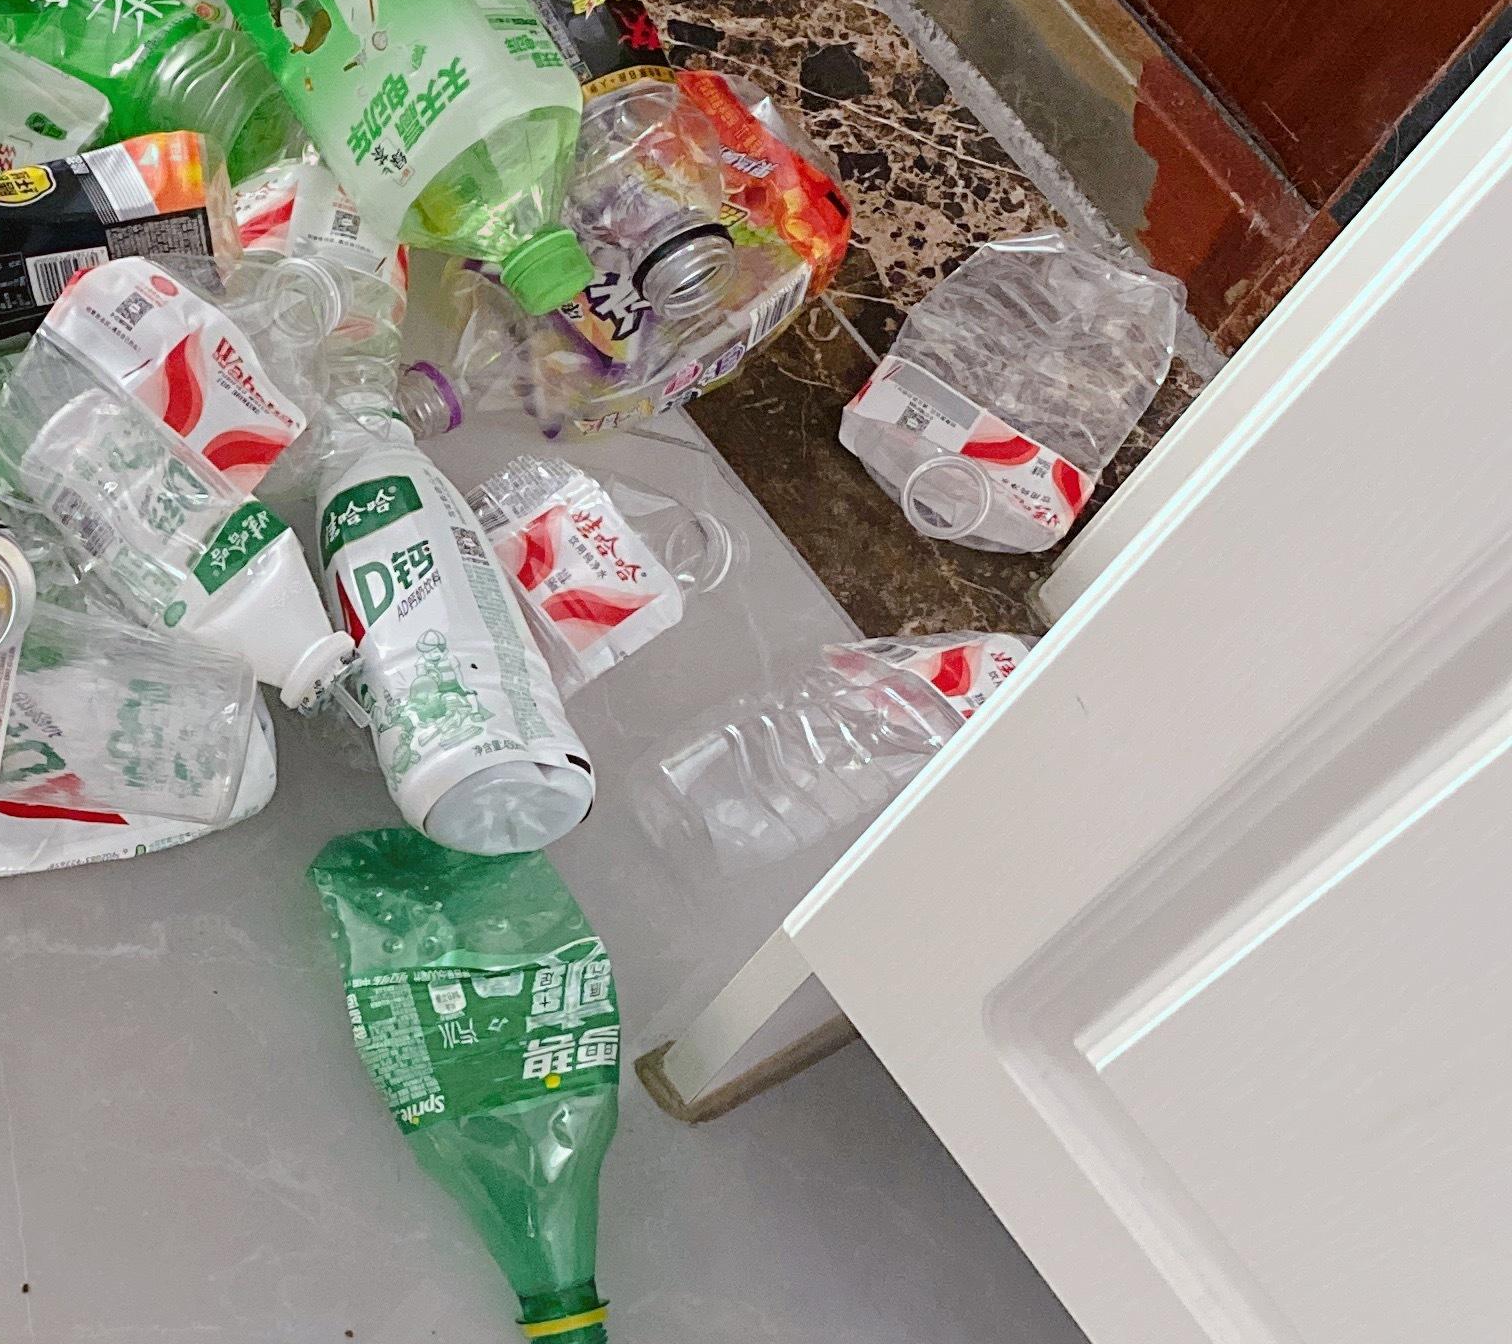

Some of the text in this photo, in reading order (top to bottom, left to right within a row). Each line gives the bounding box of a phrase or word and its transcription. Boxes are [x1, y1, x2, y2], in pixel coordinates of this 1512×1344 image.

[571, 508, 642, 585] 娃哈哈
[522, 1023, 621, 1081] 雪碧
[400, 1093, 445, 1126] Sprite
